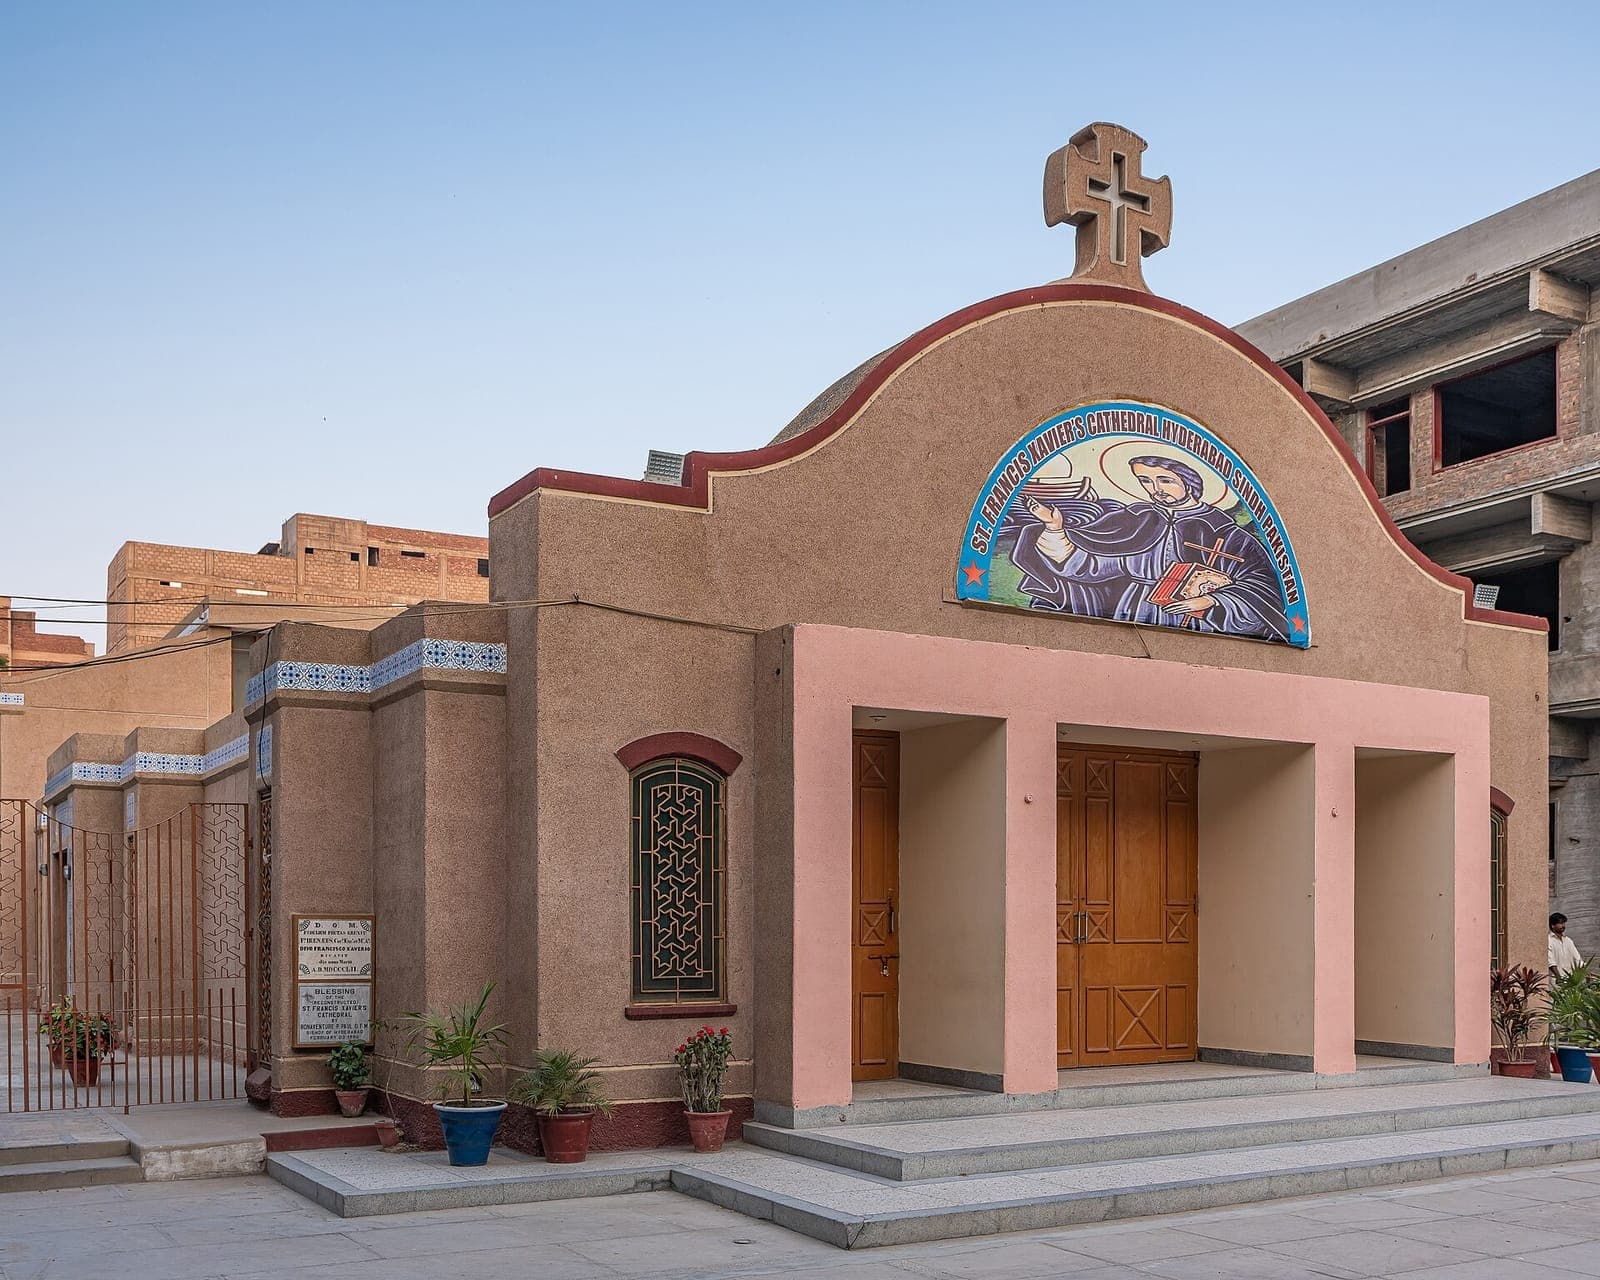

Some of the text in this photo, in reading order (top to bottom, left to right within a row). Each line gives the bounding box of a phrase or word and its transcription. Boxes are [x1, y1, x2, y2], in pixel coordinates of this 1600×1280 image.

[971, 410, 1299, 605] ST. FRANCIS XAVIER'S CATHEDRAL HYDERABAD SINDH PAKISTAN
